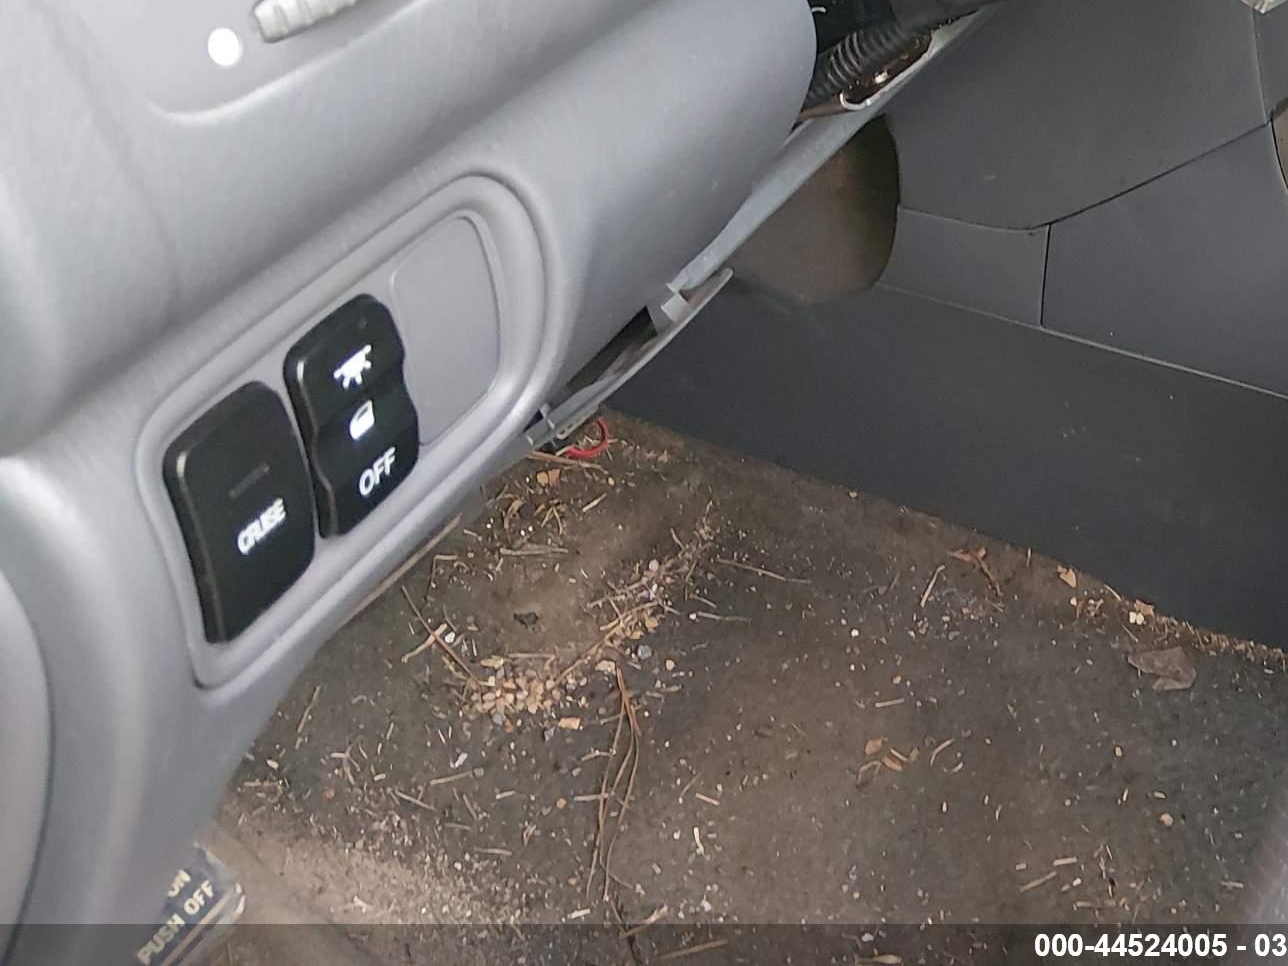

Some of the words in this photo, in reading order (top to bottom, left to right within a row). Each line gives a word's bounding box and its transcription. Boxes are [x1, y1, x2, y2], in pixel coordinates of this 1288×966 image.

[358, 446, 397, 497] OFF
[137, 913, 185, 965] PUSH
[183, 879, 214, 915] OFF
